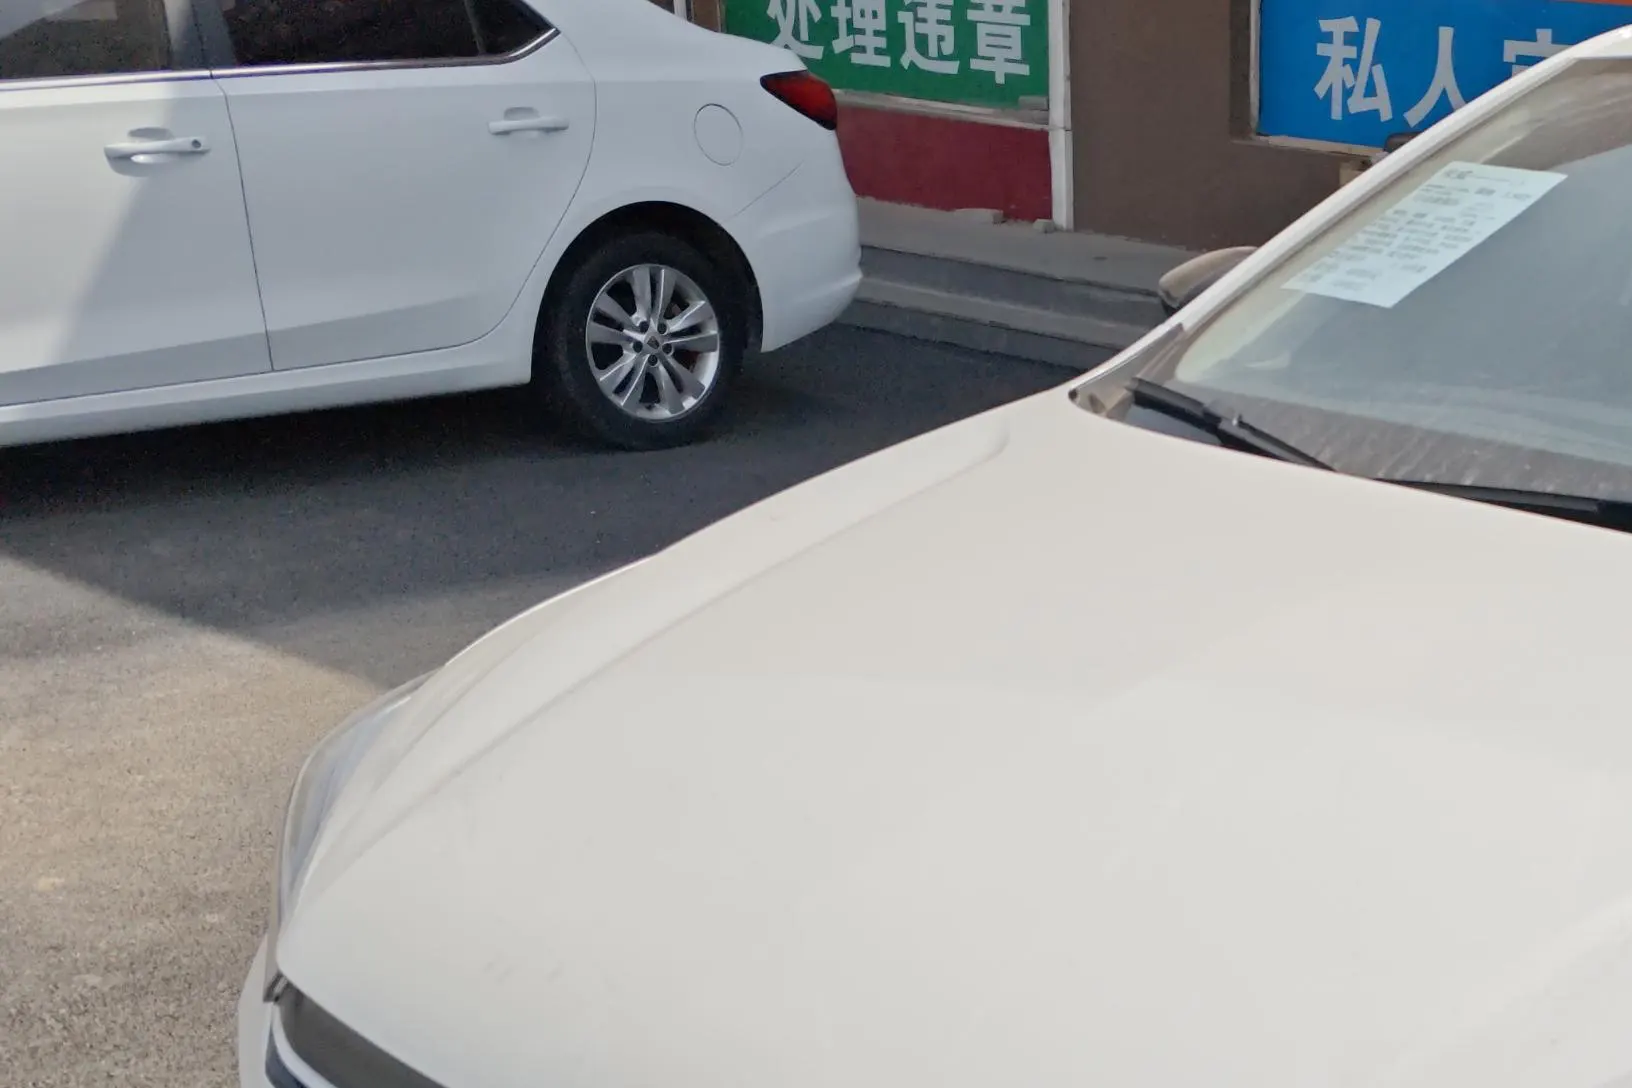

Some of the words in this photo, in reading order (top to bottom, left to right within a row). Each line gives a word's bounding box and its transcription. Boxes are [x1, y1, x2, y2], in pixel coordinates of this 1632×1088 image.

[766, 0, 1031, 85] 处理违章
[1314, 16, 1576, 128] 私人
